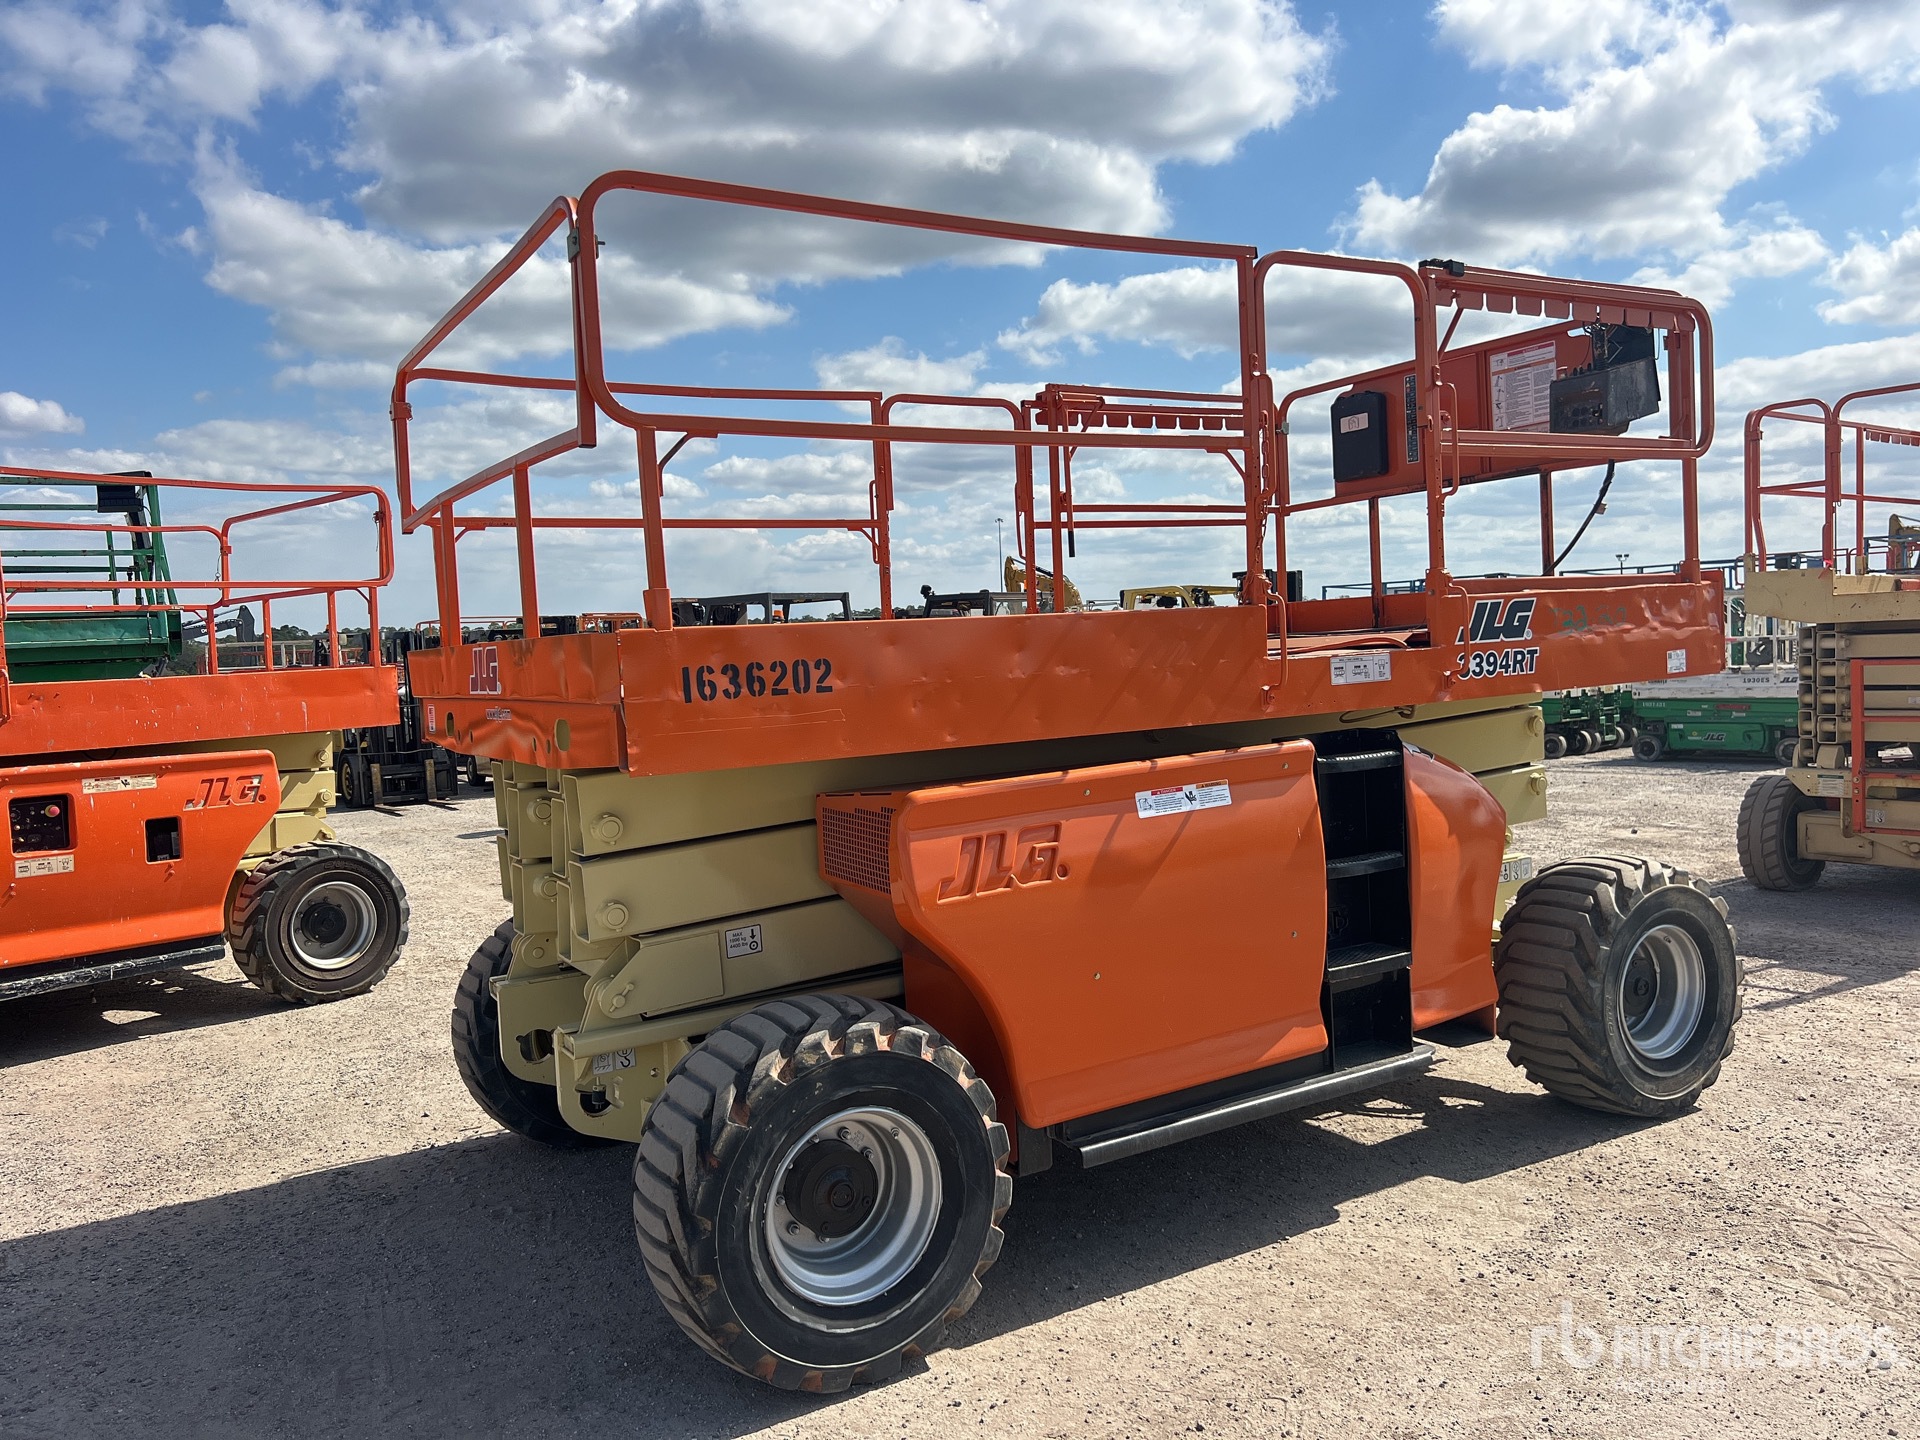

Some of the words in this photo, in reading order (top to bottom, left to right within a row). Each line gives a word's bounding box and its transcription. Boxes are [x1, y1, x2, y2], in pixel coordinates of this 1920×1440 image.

[1454, 597, 1537, 645] JLG
[469, 646, 501, 694] JLG
[682, 658, 833, 703] 1636202
[1780, 676, 1798, 684] JLG
[1702, 732, 1726, 742] JLG
